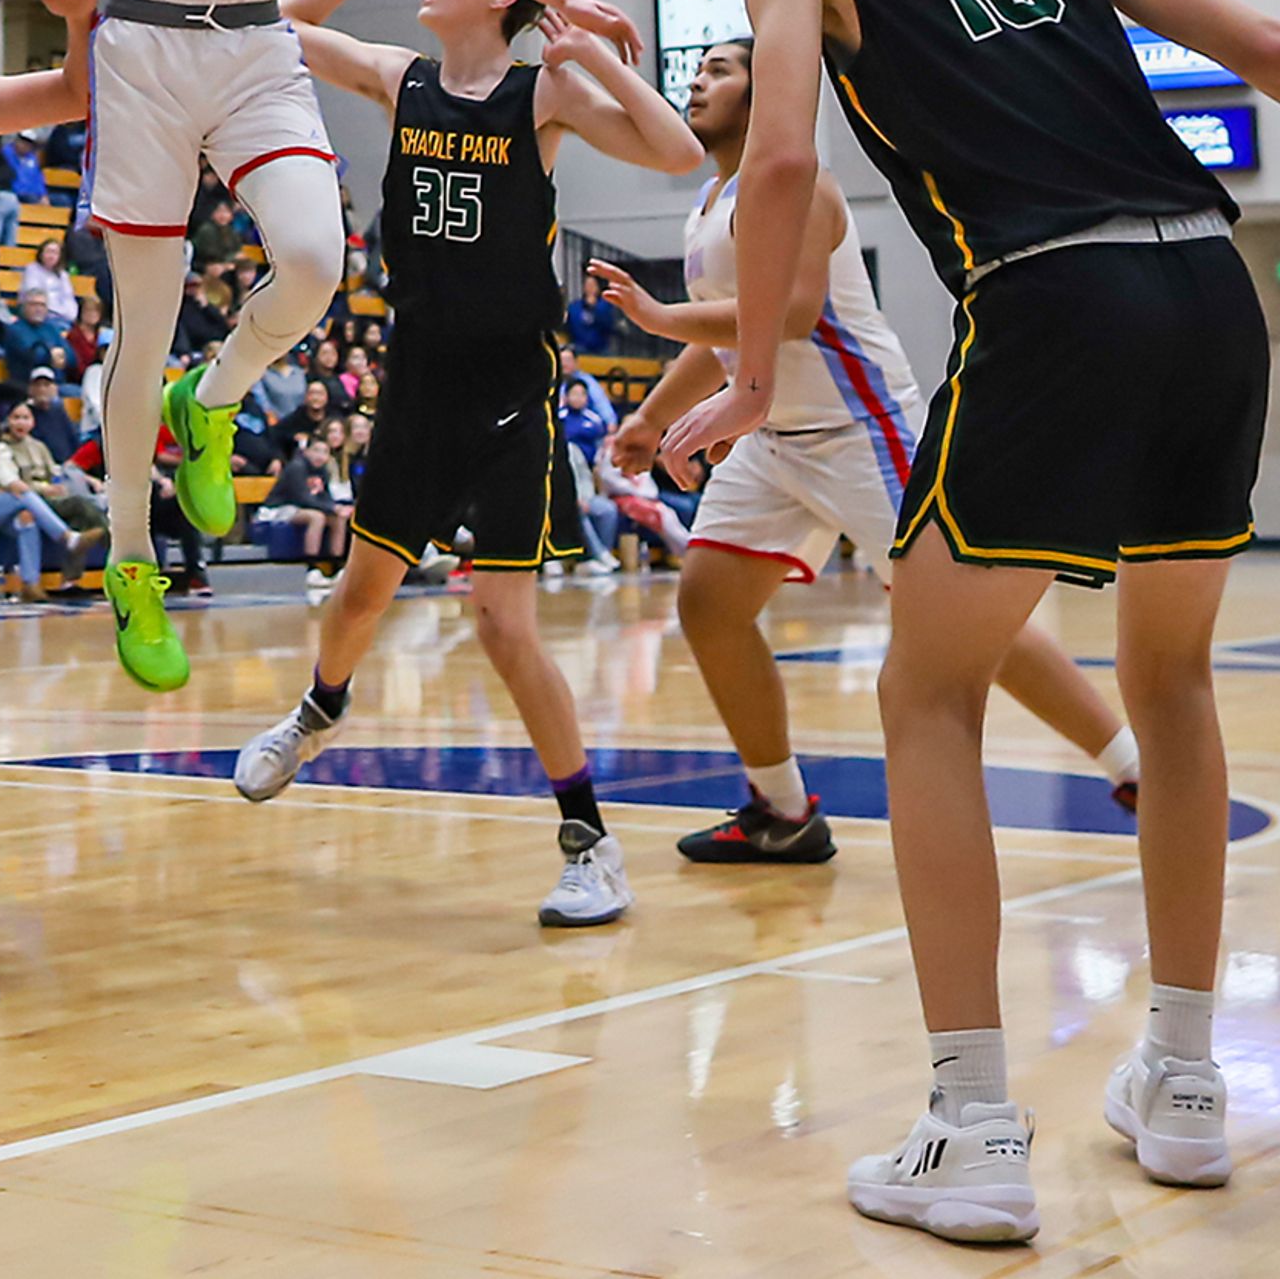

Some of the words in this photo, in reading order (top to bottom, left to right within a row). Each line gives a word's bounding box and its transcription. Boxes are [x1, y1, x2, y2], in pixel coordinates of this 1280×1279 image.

[702, 24, 714, 40] 6
[400, 126, 458, 161] SHADLE
[460, 133, 513, 166] PARK
[412, 166, 482, 243] 35
